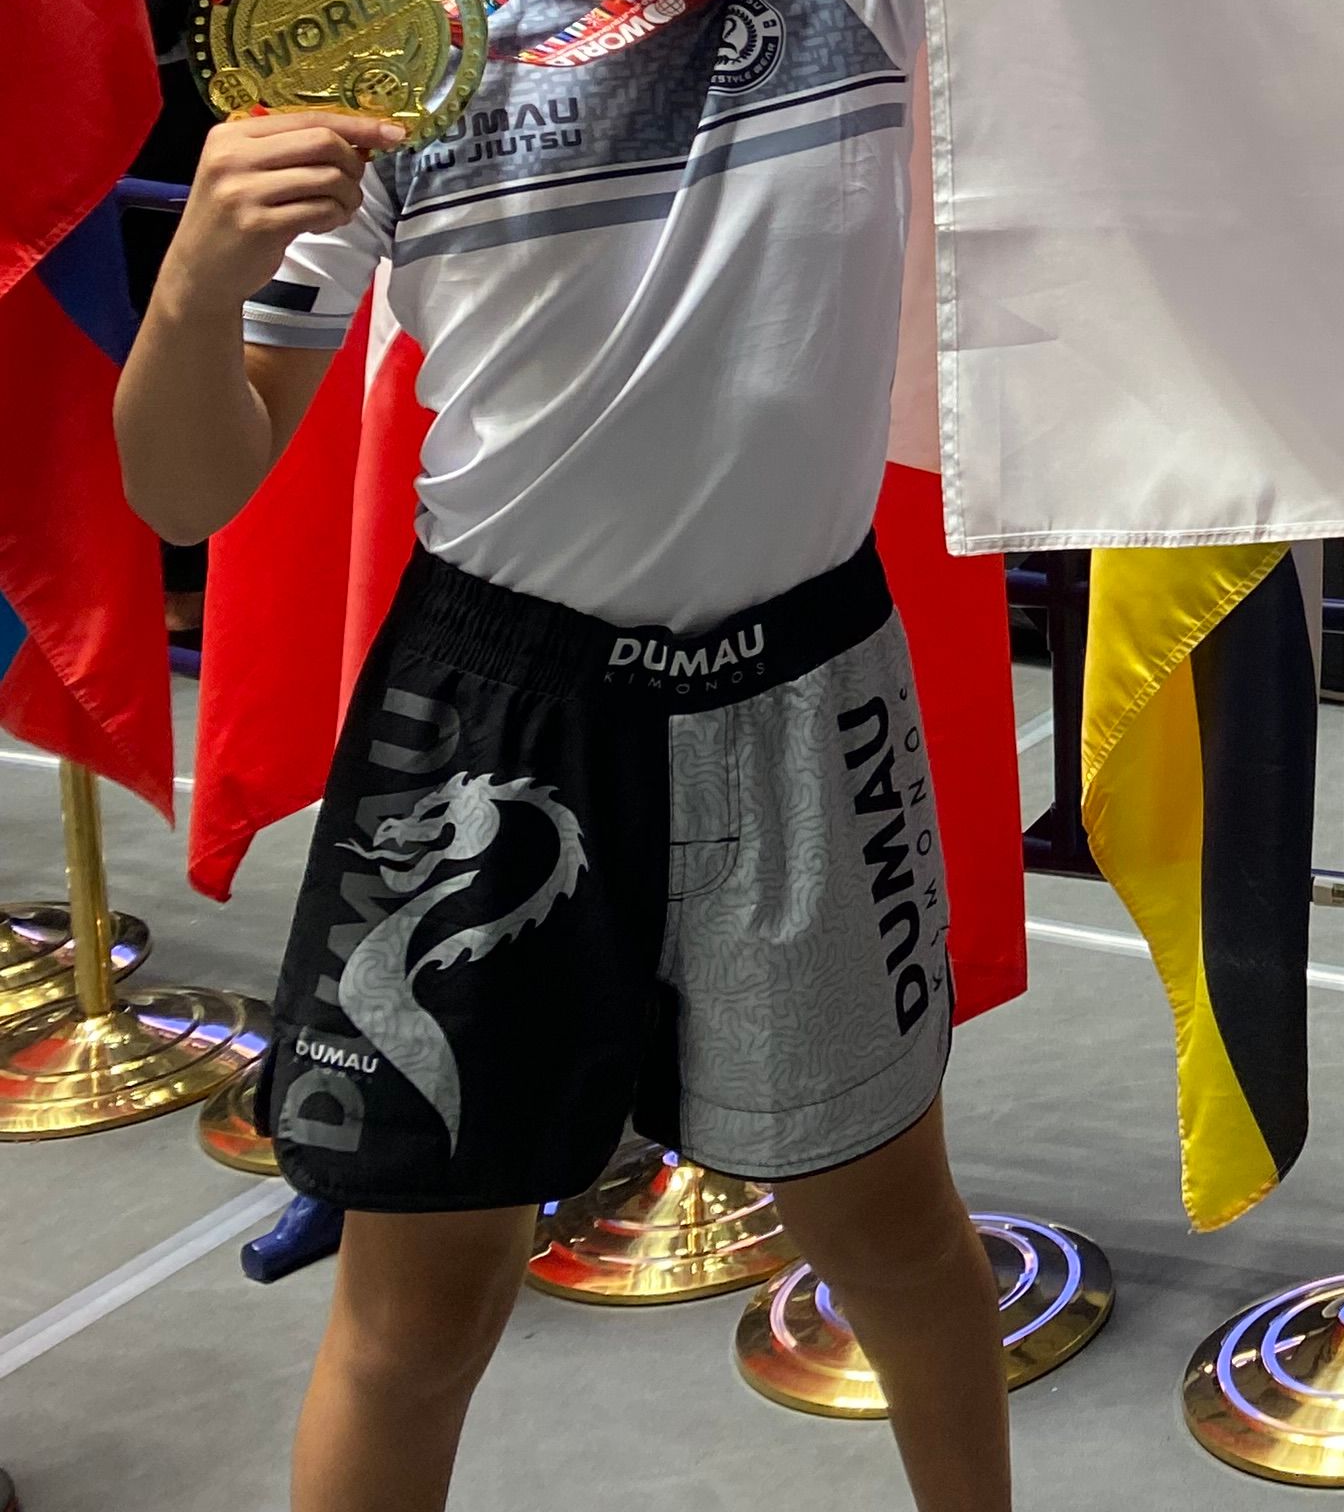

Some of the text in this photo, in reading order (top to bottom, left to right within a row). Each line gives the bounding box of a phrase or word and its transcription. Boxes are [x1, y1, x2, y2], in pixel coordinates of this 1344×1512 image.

[545, 15, 656, 67] WORLD
[608, 623, 765, 678] DUMAU
[603, 662, 765, 695] KIMONOS
[837, 695, 929, 1037] DUMAU
[296, 1039, 379, 1073] DUMAU
